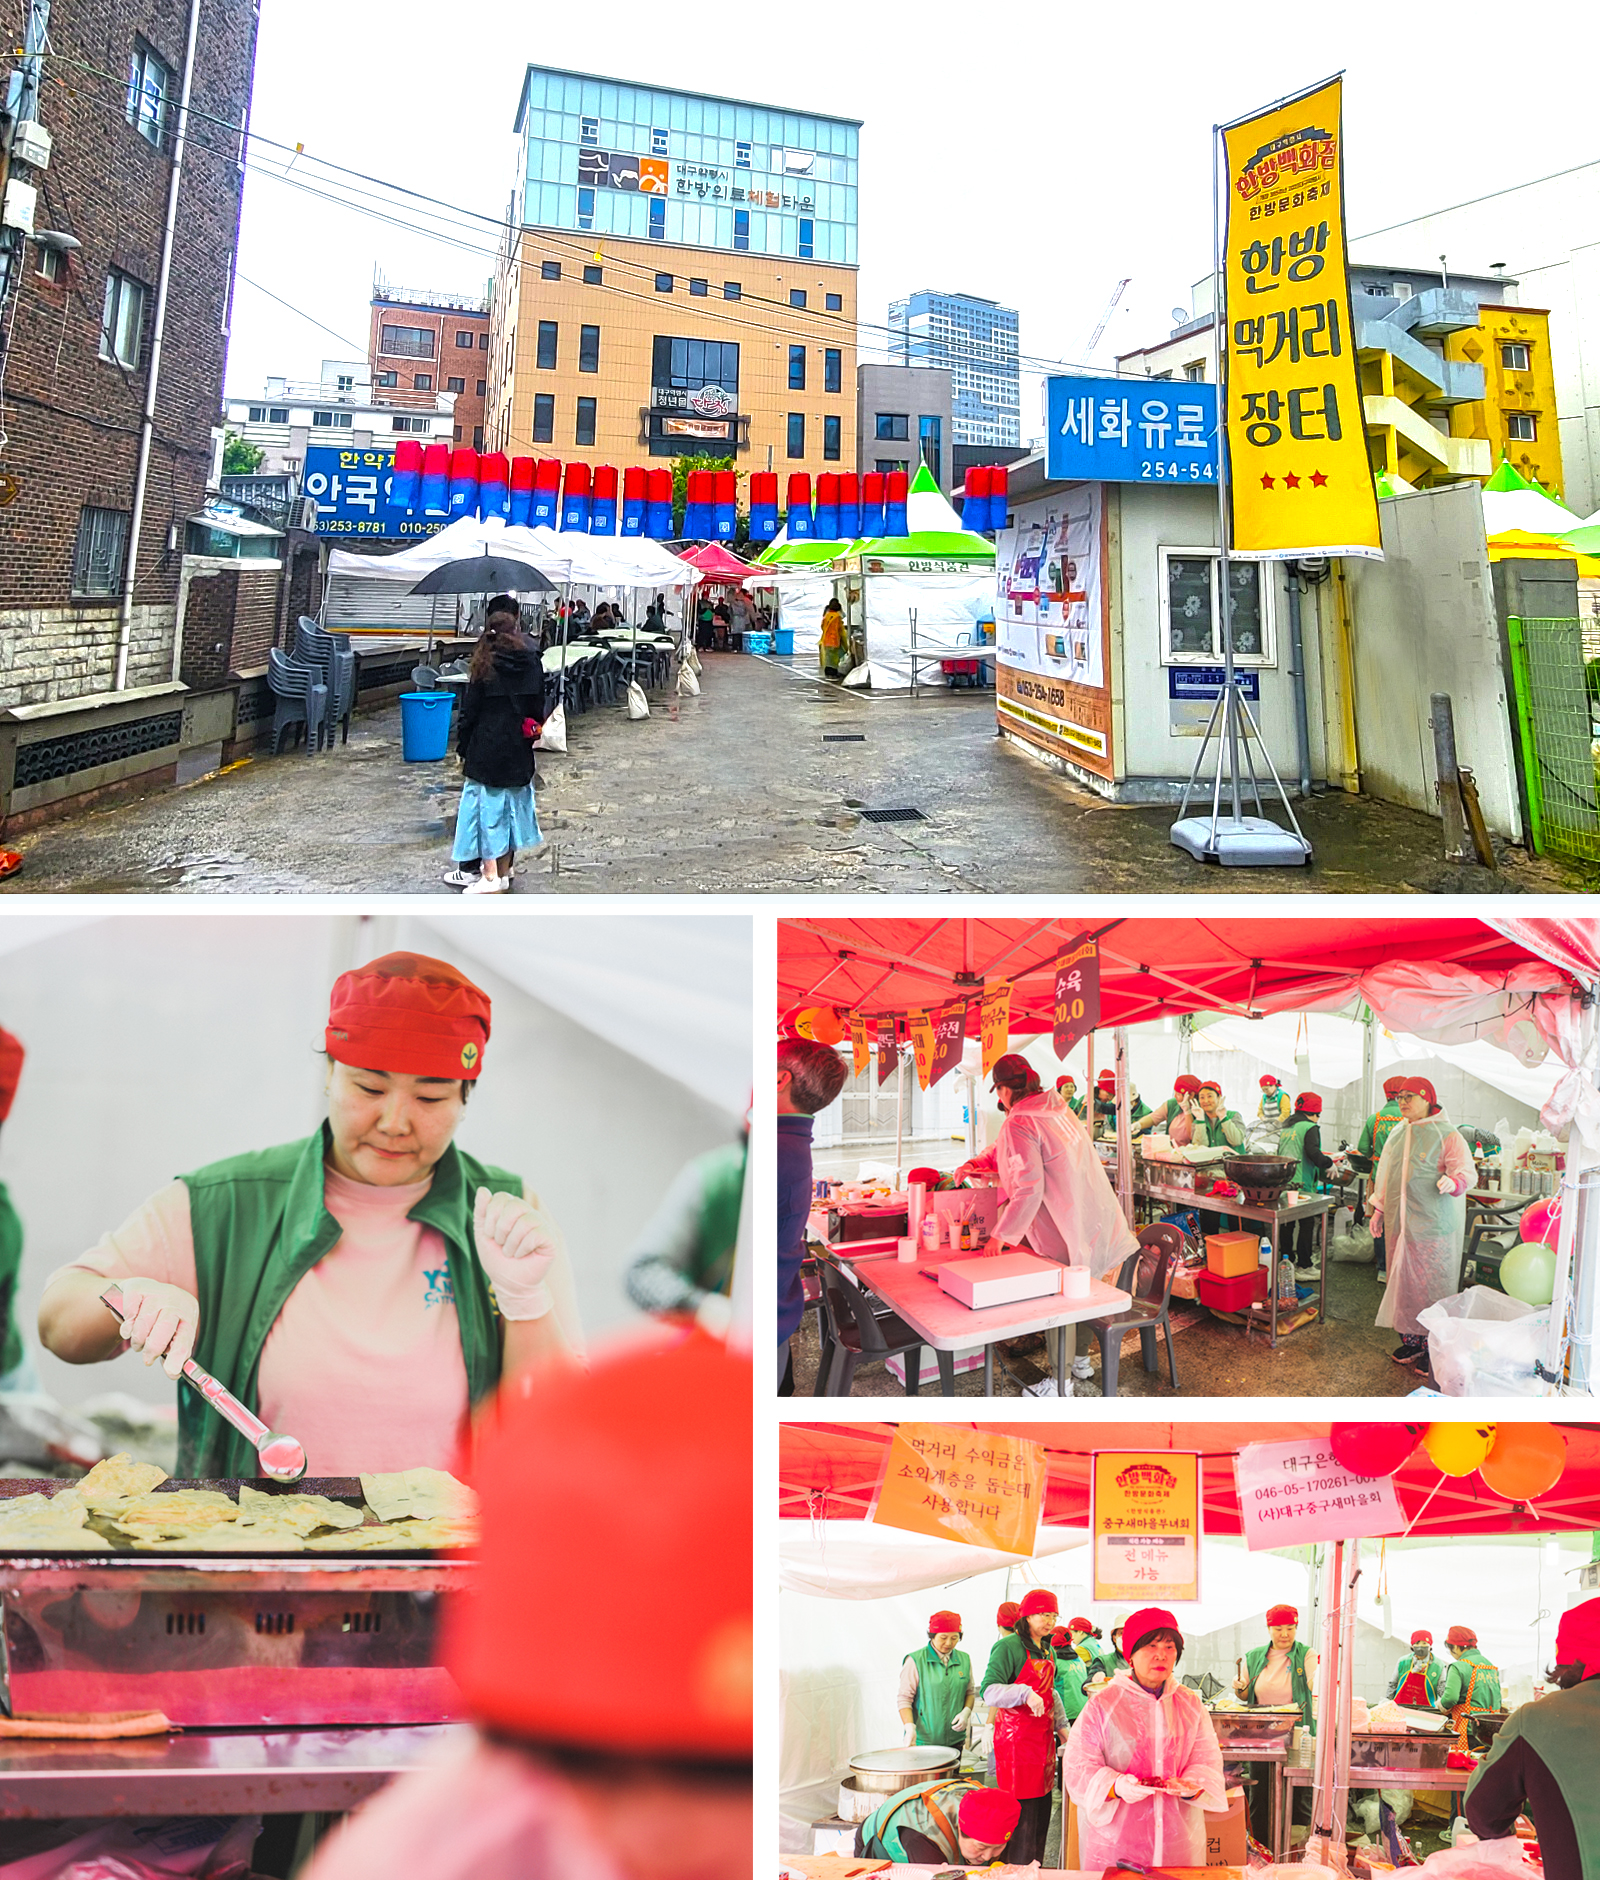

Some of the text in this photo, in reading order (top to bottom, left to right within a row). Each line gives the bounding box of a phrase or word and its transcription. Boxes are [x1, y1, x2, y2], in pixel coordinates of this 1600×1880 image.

[1235, 140, 1337, 201] 한방백화점
[676, 178, 815, 212] 한방의료체험타운
[1249, 180, 1331, 221] 한방문화축제
[1240, 220, 1331, 295] 한방
[1234, 298, 1342, 369] 먹거리
[1240, 383, 1342, 447] 장터
[1141, 461, 1219, 479] 254-54
[1055, 970, 1082, 999] 수육
[911, 1439, 1027, 1472] 먹거리 수익금은
[897, 1464, 1031, 1500] 소외계층을 돕는데
[1115, 1471, 1178, 1489] 한방백화점
[1124, 1490, 1170, 1498] 한방문화축제
[921, 1494, 1002, 1521] 사용합니다
[1258, 1490, 1382, 1522] (사)대구중구새마을회
[1102, 1517, 1190, 1530] 중구새마을부녀회
[1124, 1547, 1169, 1562] 전 메뉴
[1133, 1567, 1160, 1581] 가능
